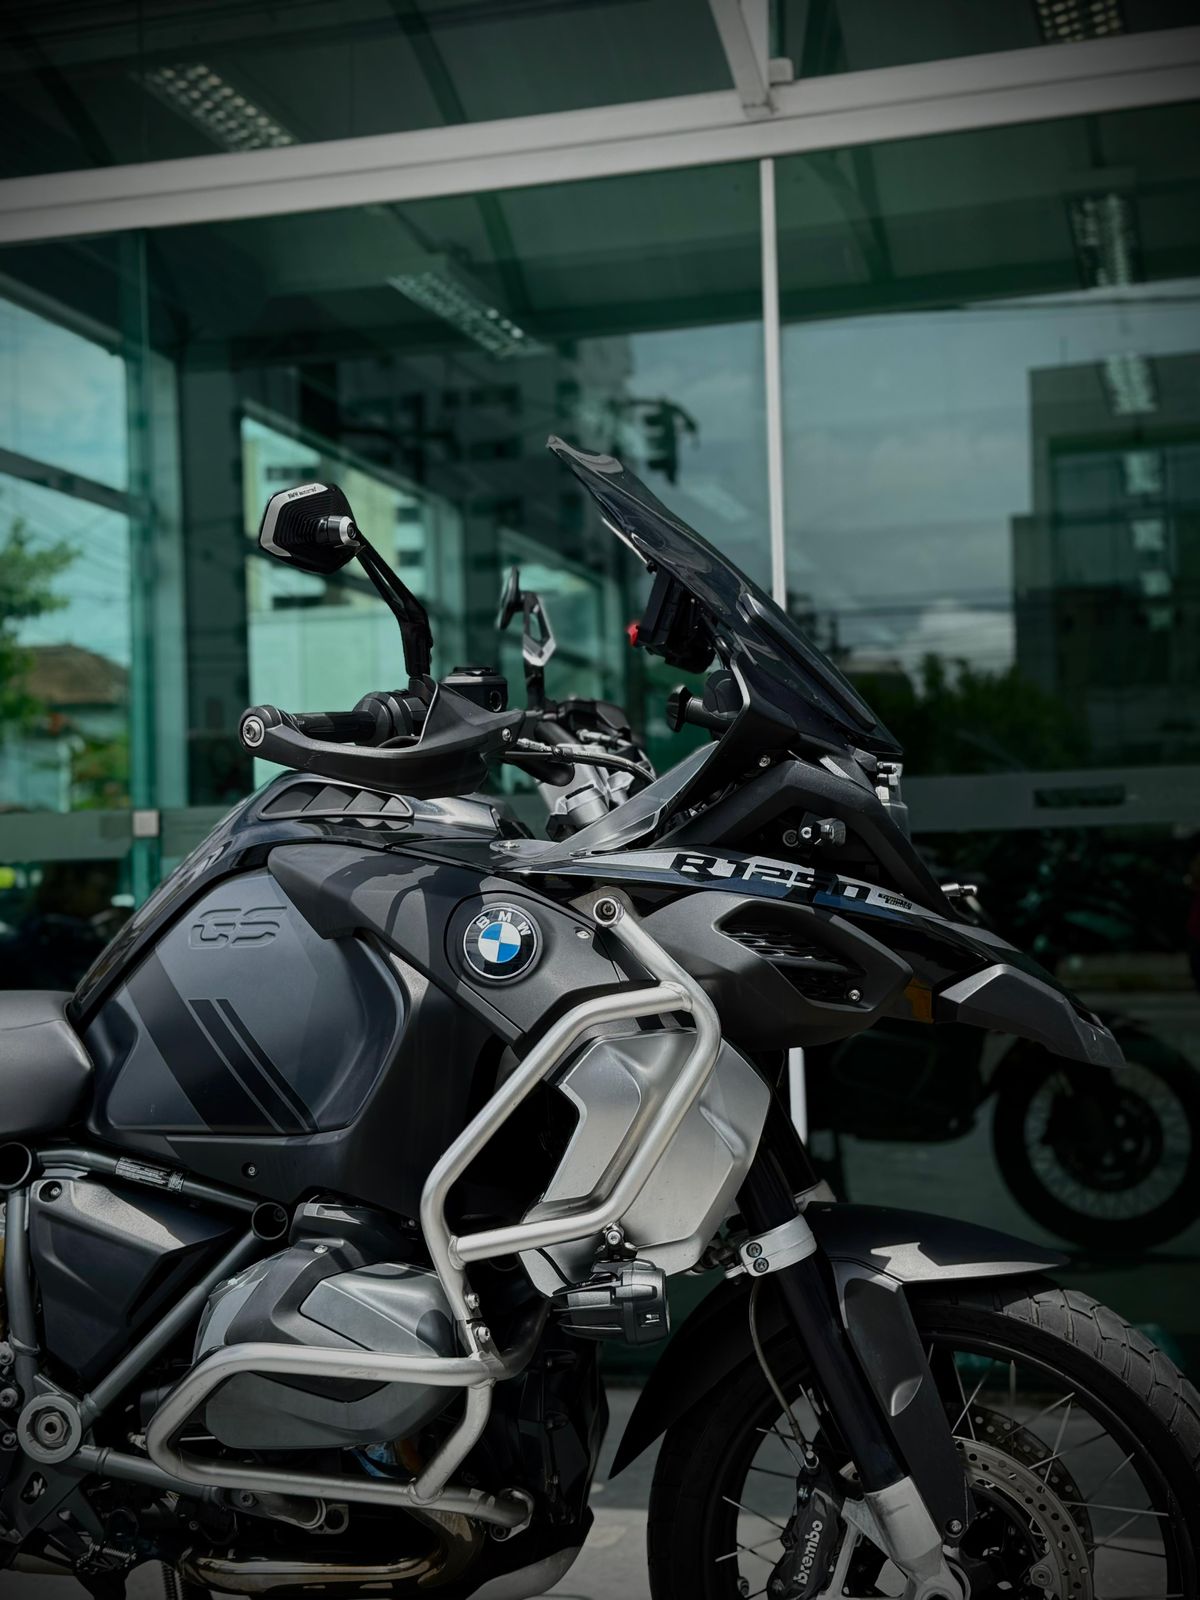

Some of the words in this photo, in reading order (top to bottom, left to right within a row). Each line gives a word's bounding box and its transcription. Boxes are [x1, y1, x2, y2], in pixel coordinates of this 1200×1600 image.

[189, 905, 287, 949] GS
[476, 910, 531, 936] BMW
[792, 1520, 823, 1585] brembo
